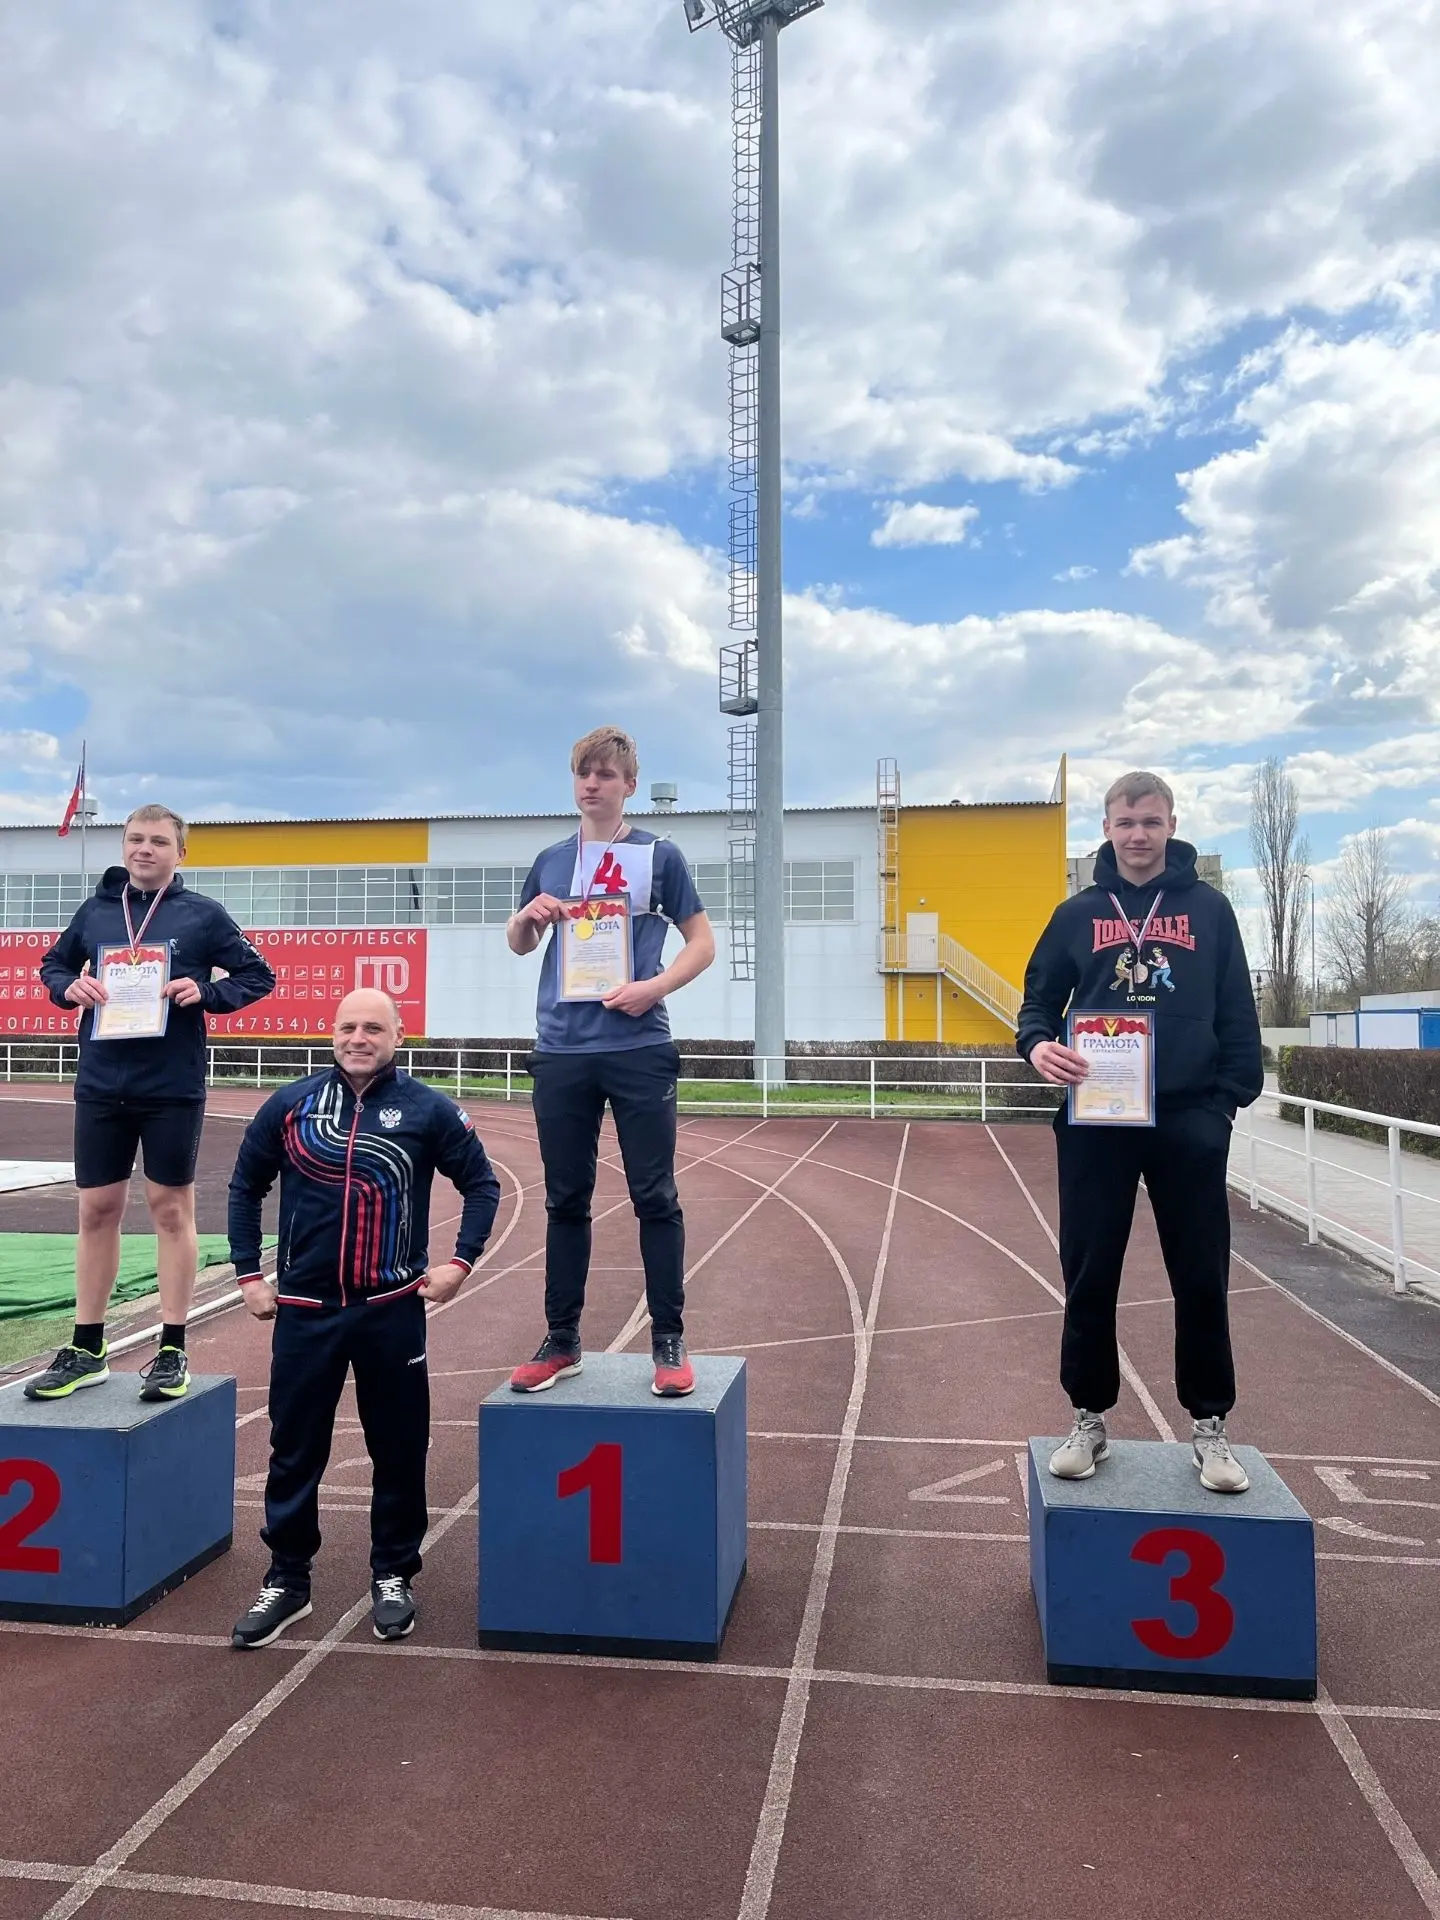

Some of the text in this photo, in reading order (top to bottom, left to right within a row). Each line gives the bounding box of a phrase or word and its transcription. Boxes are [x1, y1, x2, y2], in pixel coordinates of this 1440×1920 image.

[593, 852, 628, 894] 4
[255, 931, 417, 946] БОРИСОГЛЕБСК
[1092, 914, 1196, 953] LONSALE
[354, 956, 410, 994] ГТО
[209, 1017, 217, 1031] 8
[226, 1017, 308, 1034] (47354)
[1083, 1038, 1140, 1049] ГРАМОТА
[0, 1457, 62, 1575] 2
[556, 1441, 623, 1565] 1
[1129, 1527, 1236, 1660] 3
